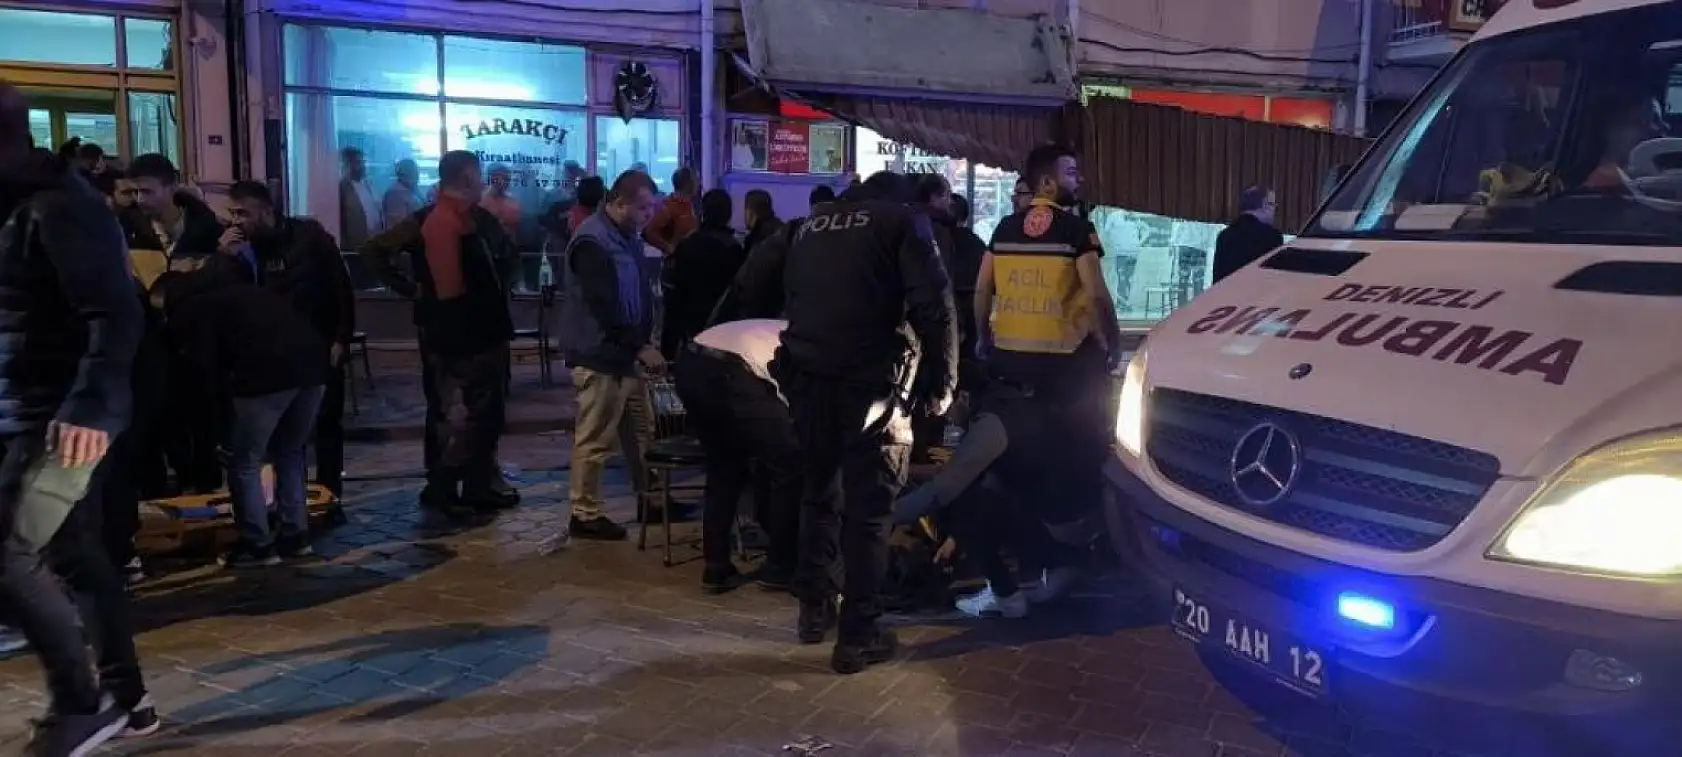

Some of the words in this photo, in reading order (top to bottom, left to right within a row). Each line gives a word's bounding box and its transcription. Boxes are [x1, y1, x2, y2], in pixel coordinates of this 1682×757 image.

[1184, 598, 1209, 634] 20
[1226, 618, 1269, 664] AAH
[1290, 647, 1322, 685] 12
